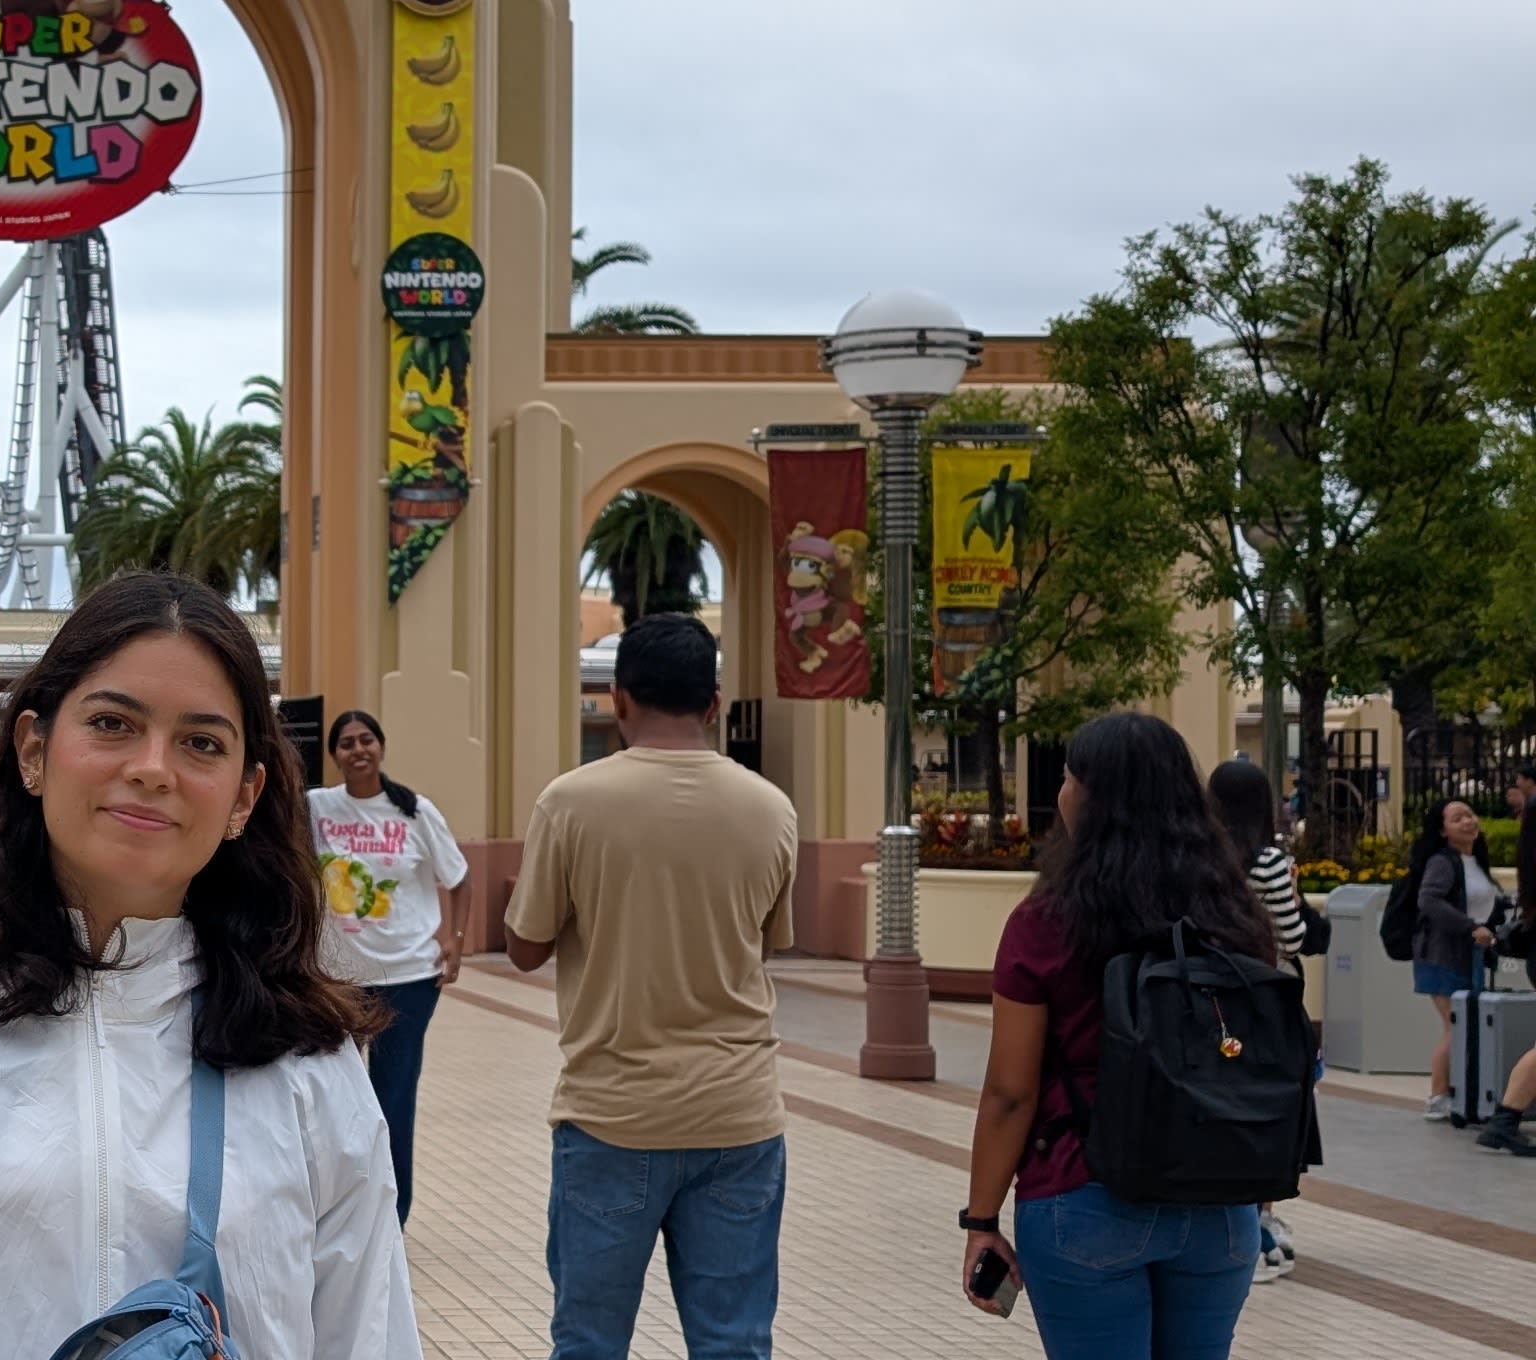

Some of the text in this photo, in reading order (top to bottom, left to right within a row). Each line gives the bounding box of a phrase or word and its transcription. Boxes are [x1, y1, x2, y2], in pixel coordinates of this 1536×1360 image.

[411, 257, 455, 270] SUPER
[384, 272, 482, 289] NINTENDO
[399, 288, 467, 305] WORLD
[319, 817, 375, 838] Costa
